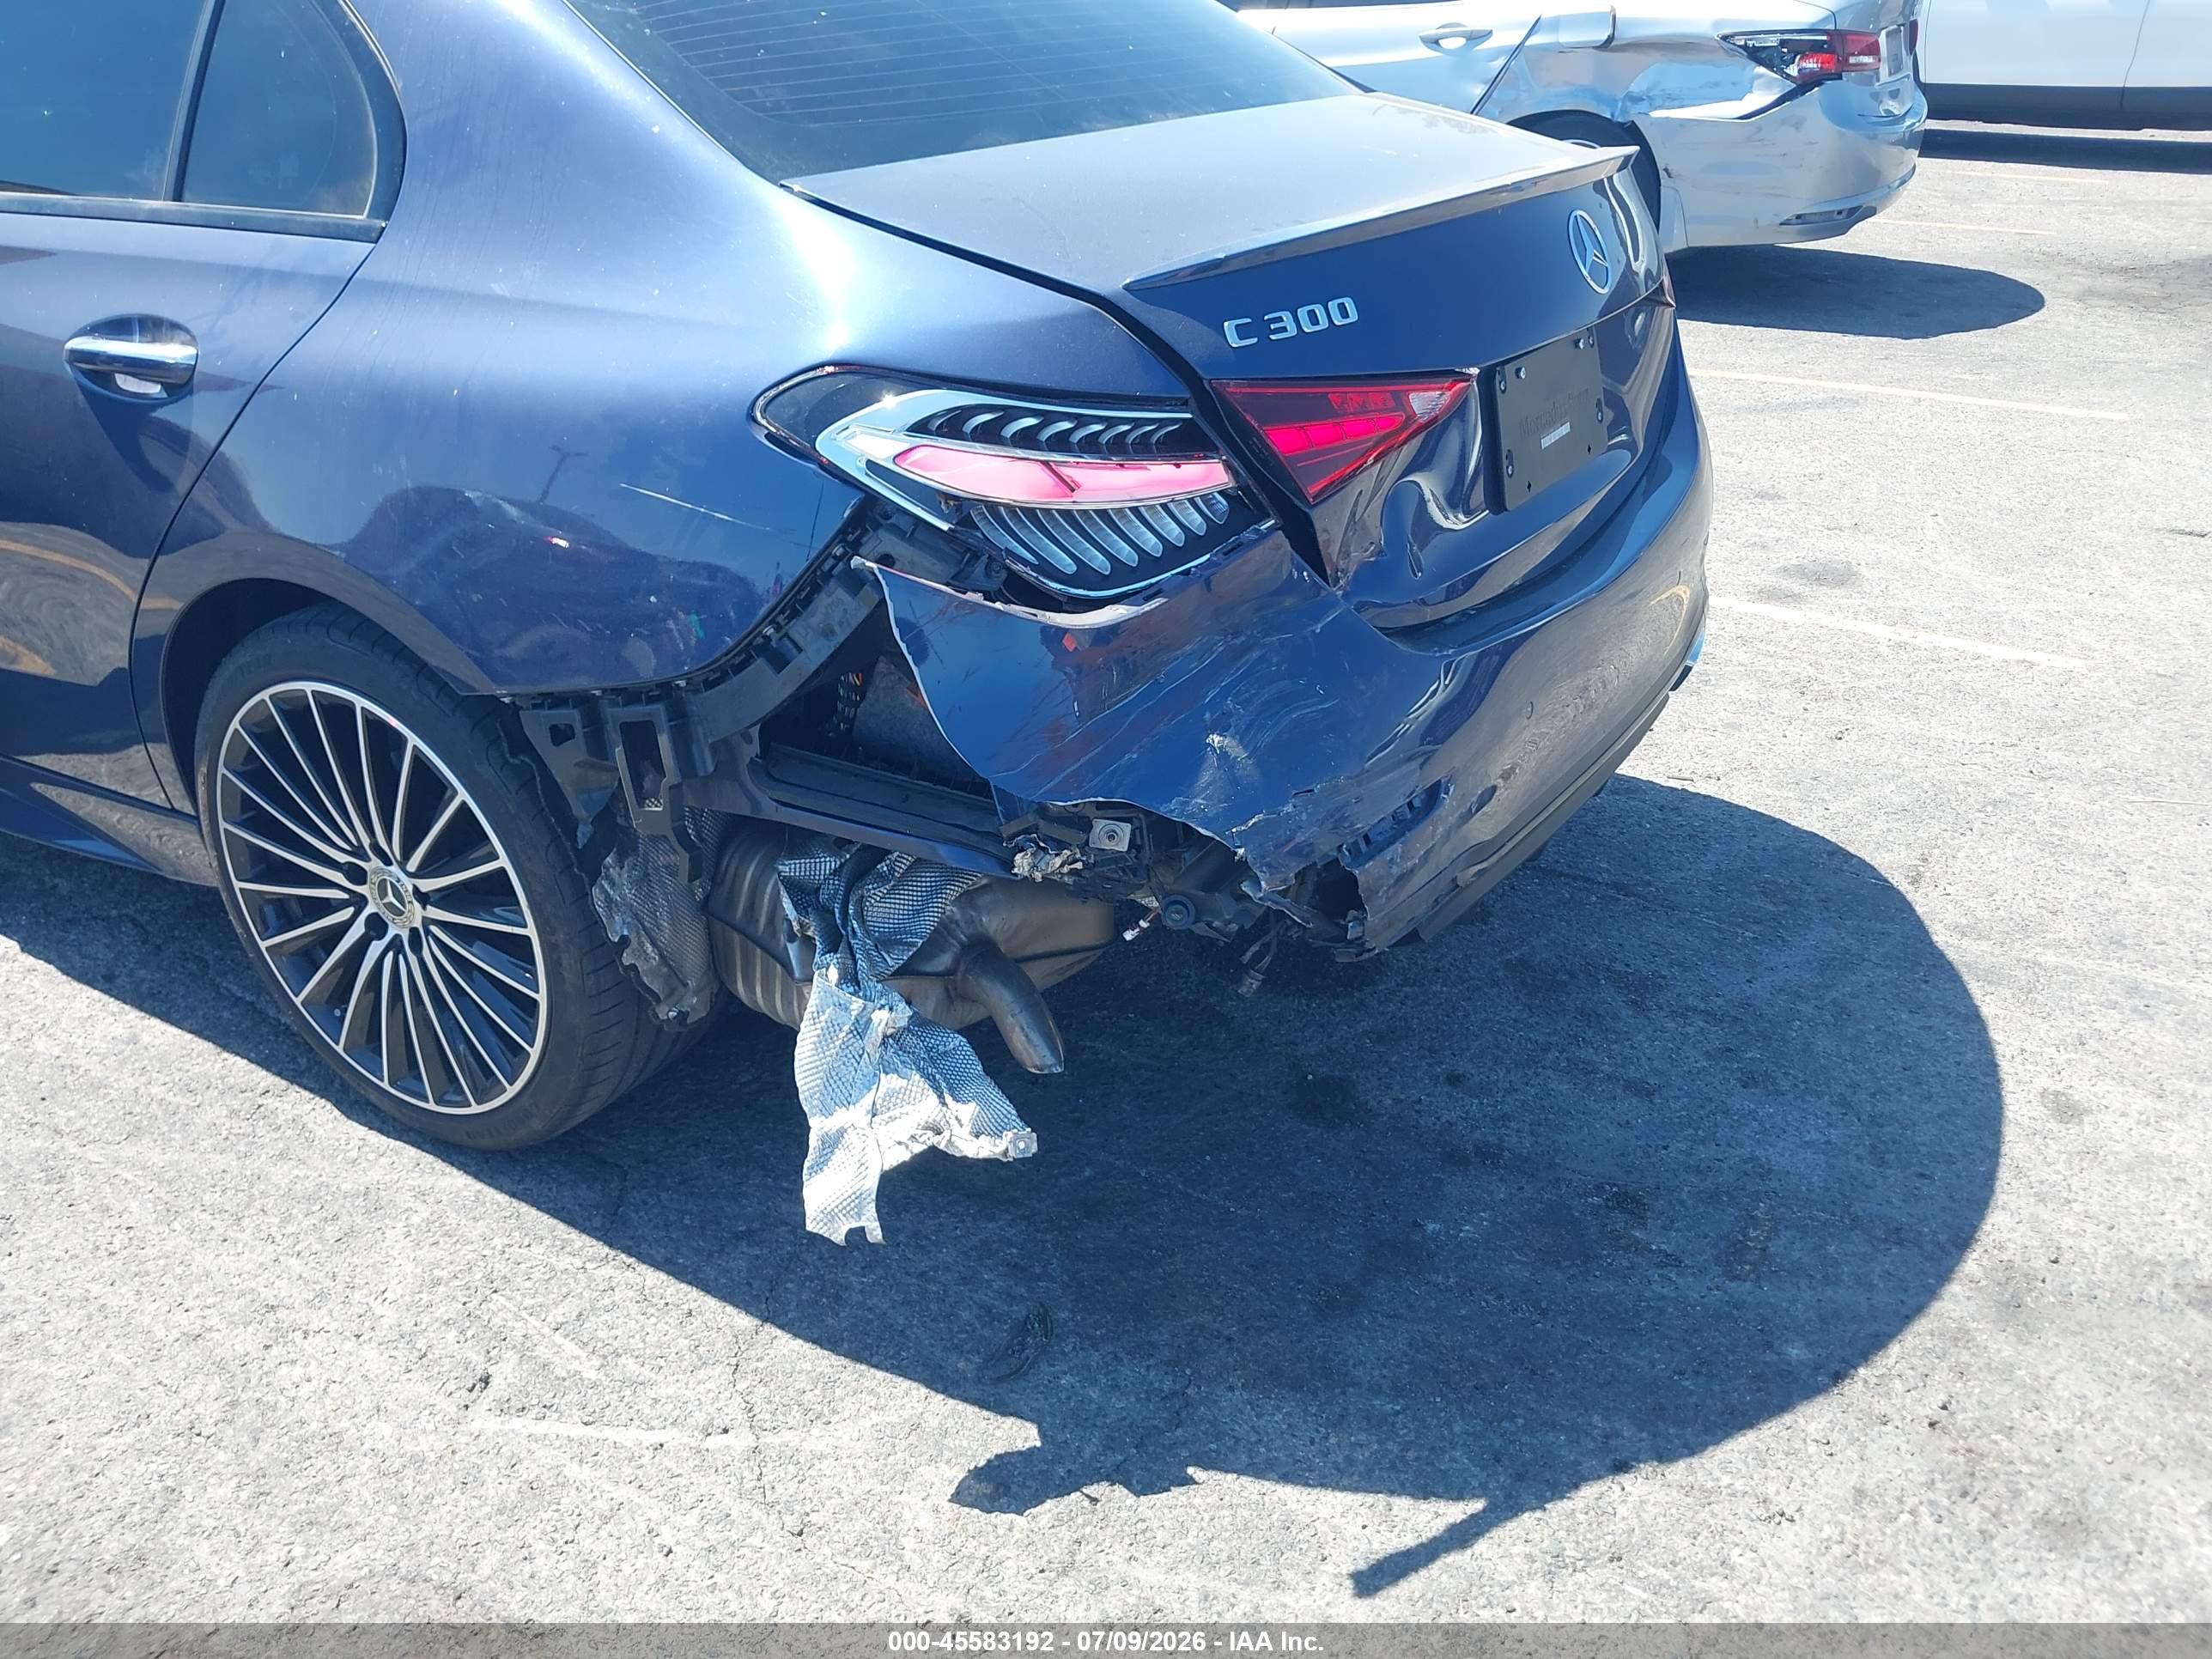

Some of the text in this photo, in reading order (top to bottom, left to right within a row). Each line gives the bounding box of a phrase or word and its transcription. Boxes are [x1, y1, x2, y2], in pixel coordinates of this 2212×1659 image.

[1223, 296, 1358, 348] C 300
[1518, 387, 1589, 440] Mercedes
